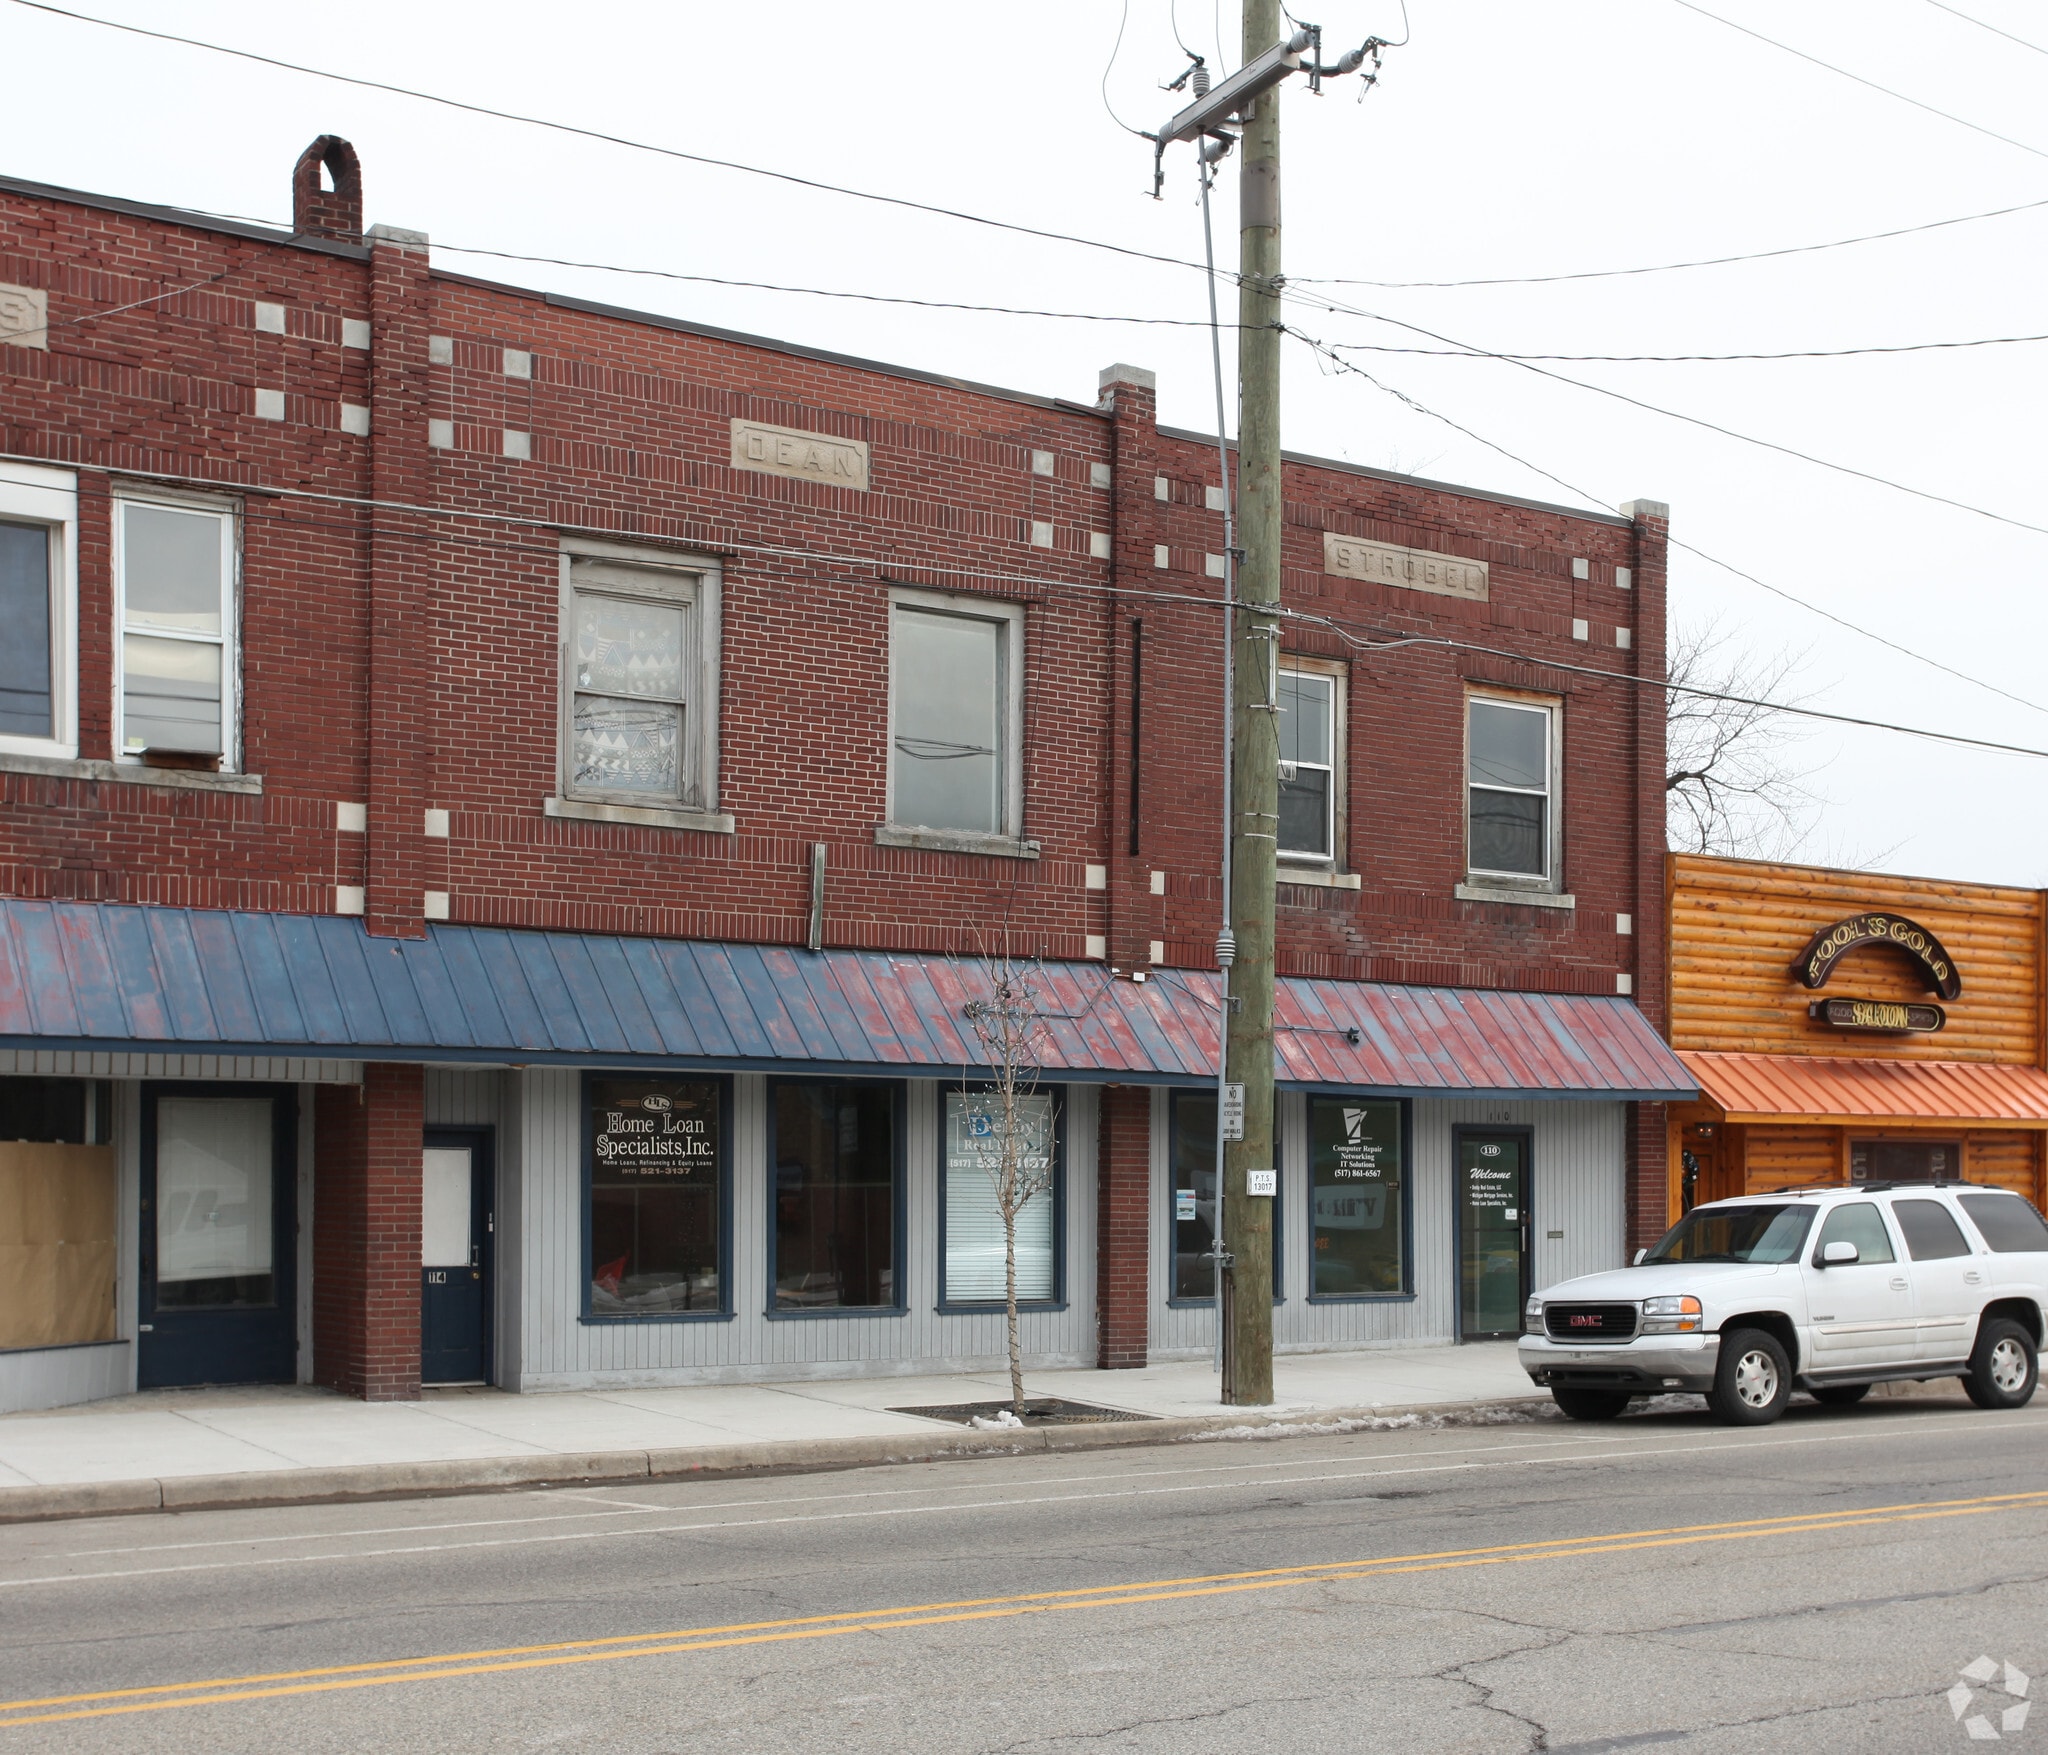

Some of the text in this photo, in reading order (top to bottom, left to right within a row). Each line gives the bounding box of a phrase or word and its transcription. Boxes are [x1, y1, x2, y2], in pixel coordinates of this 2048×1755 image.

[746, 432, 853, 478] DEAN
[1337, 547, 1477, 592] STROBEL
[1808, 917, 1949, 981] FOOL'S GOLD
[1853, 1002, 1908, 1028] SALOON
[1229, 1090, 1237, 1099] NO
[647, 1096, 670, 1110] HLS
[1490, 1112, 1510, 1121] 110
[607, 1112, 704, 1133] Home Loan
[1332, 1145, 1383, 1153] Computer Repair
[1341, 1153, 1375, 1161] Networking
[950, 1159, 971, 1168] (517)
[640, 1167, 691, 1175] 521-3137
[1334, 1169, 1381, 1178] (517) 861-6567
[1470, 1167, 1511, 1179] Welcome
[1254, 1182, 1272, 1191] 13017
[430, 1272, 445, 1282] 114
[1570, 1315, 1602, 1327] GMC
